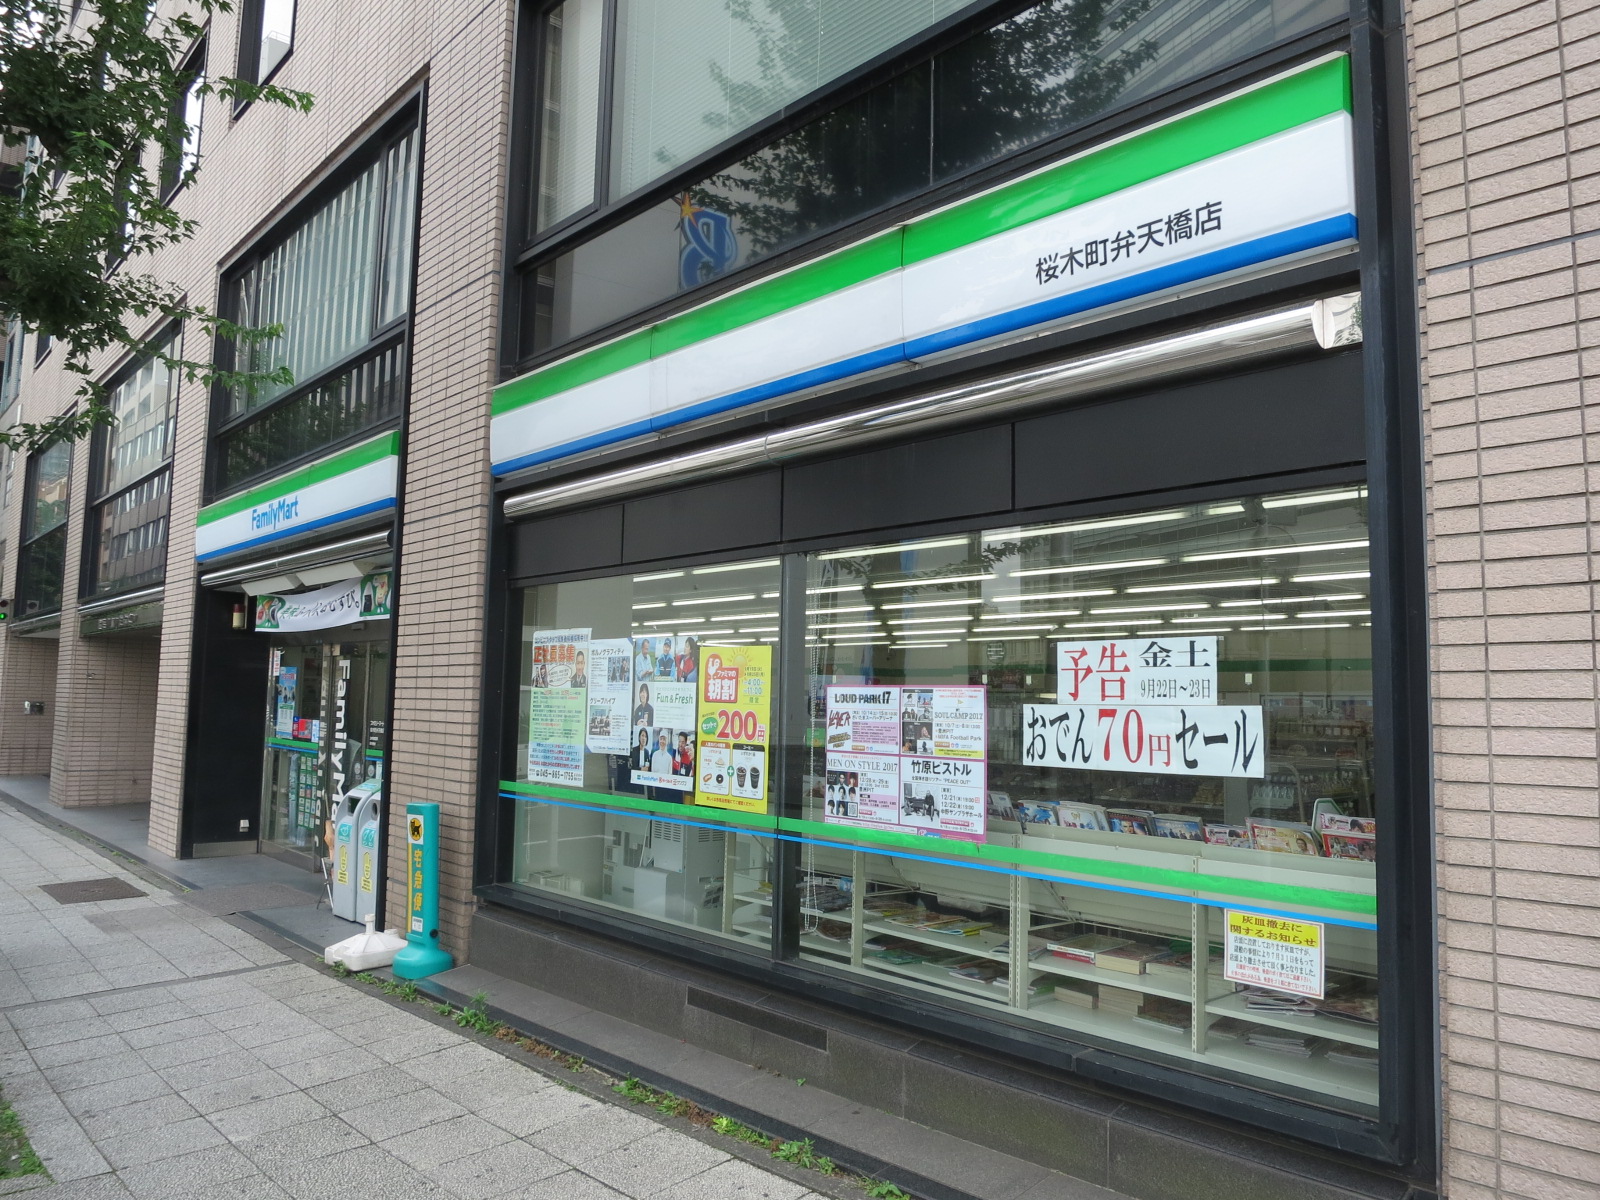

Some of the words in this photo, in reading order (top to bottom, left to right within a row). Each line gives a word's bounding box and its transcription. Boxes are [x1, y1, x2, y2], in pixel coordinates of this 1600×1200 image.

[1035, 200, 1223, 285] 桜木町弁天橋店
[251, 495, 299, 531] FamilyMart
[534, 644, 575, 663] 正社員募集
[591, 648, 624, 656] ポルノグラフィティ
[1061, 643, 1131, 701] 予告
[1139, 640, 1211, 667] 金土
[656, 692, 669, 703] Fun
[669, 695, 674, 703] &
[674, 693, 694, 704] Fresh
[708, 679, 736, 700] 朝割
[834, 694, 857, 704] LOUD
[859, 694, 881, 704] PARK
[590, 697, 616, 705] クリープハイプ
[934, 712, 950, 720] SOUL
[950, 712, 968, 720] CAMP
[1026, 706, 1258, 773] おでん70円セール
[827, 758, 843, 767] MEN
[844, 759, 856, 769] ON
[857, 760, 881, 771] STYLE
[882, 762, 898, 772] 2017
[911, 760, 972, 776] 竹原ピストル
[940, 809, 983, 819] 中野サンプラザホール
[413, 848, 423, 912] 宅急便
[1242, 914, 1303, 933] 灰皿撤去に
[1230, 924, 1317, 947] 関するお知らせ
